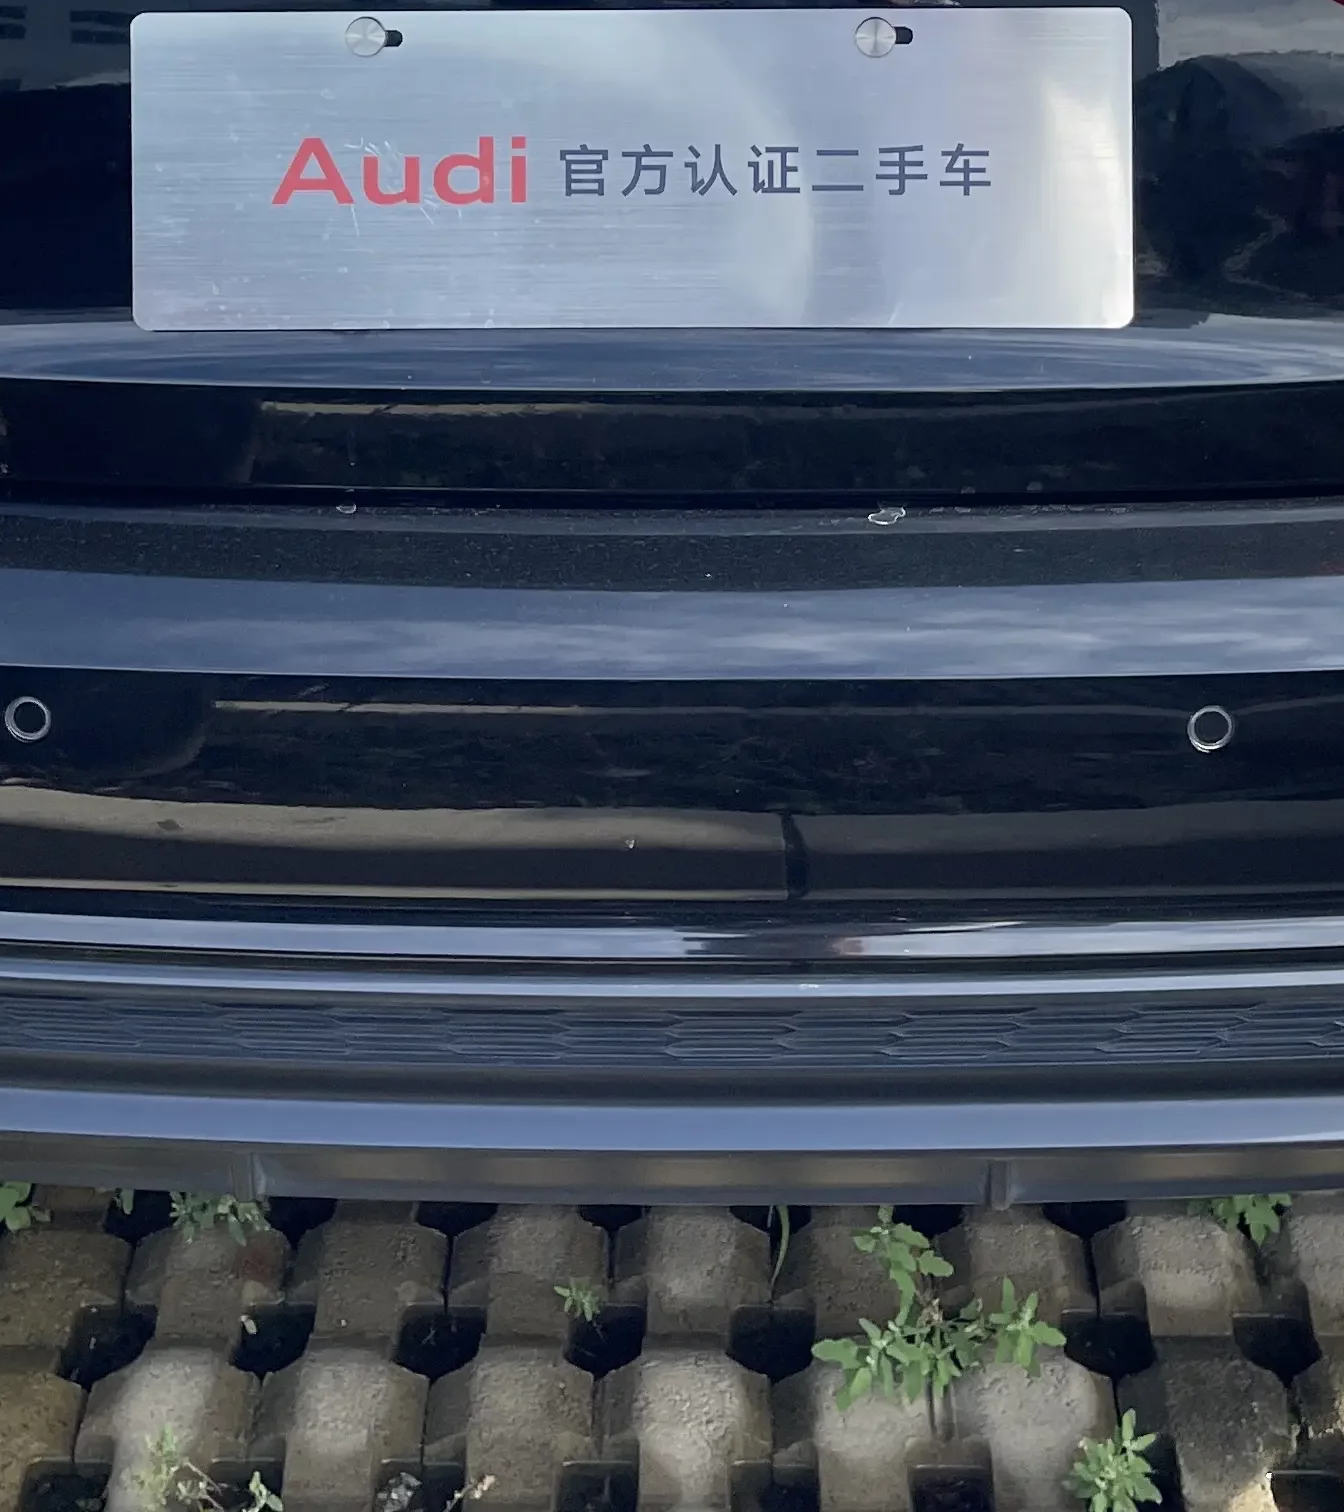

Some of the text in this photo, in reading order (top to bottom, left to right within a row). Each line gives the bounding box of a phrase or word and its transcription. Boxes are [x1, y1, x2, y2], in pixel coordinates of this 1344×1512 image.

[272, 136, 993, 206] Audi 官方认证二手车
